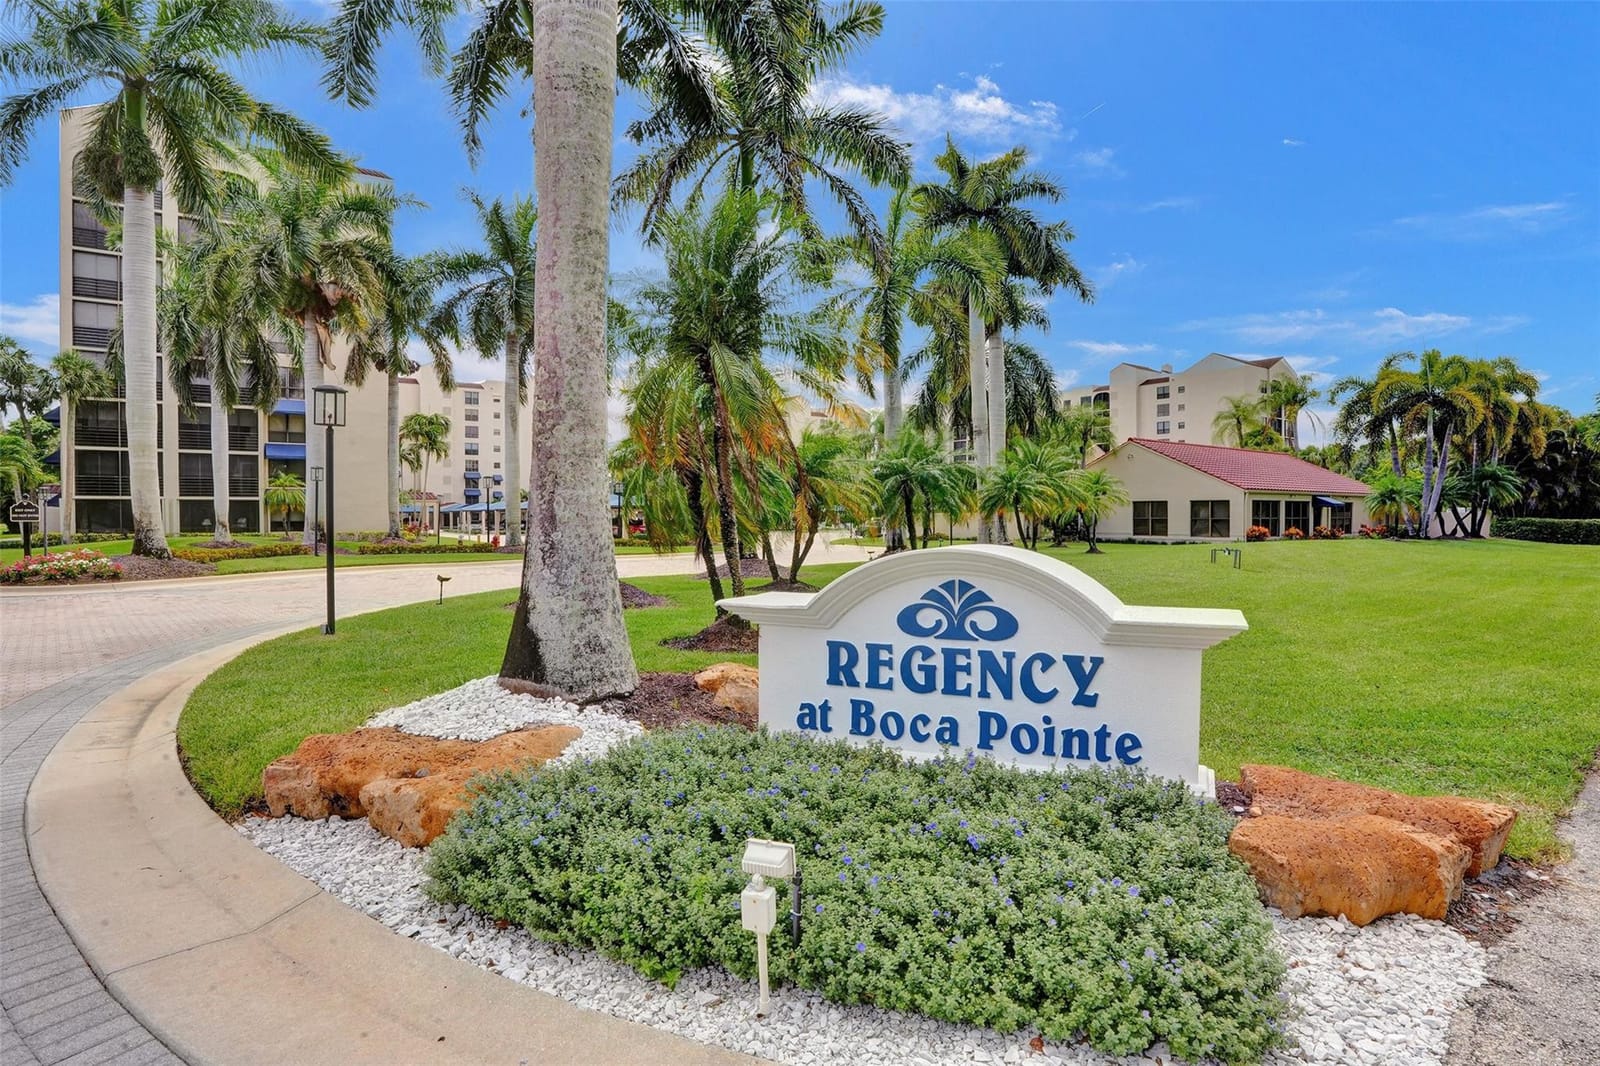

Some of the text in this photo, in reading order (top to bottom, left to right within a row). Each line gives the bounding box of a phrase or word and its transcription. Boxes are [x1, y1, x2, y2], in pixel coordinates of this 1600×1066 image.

[826, 640, 1104, 708] REGENCY
[796, 698, 1142, 766] at Boca Pointe
